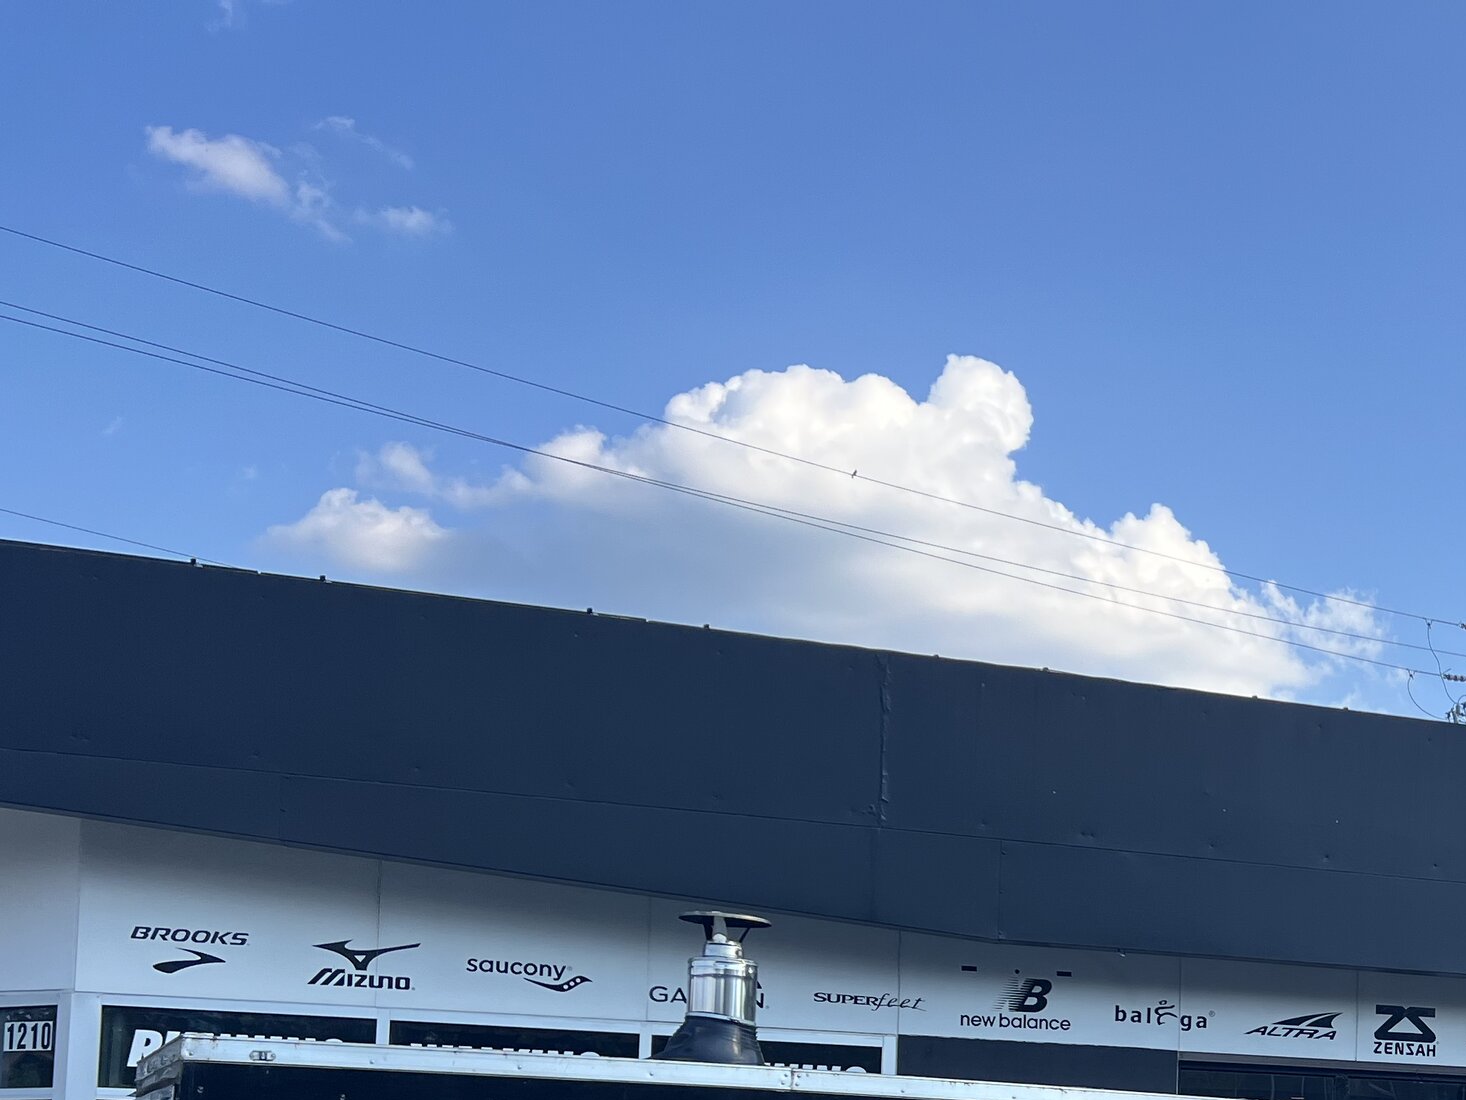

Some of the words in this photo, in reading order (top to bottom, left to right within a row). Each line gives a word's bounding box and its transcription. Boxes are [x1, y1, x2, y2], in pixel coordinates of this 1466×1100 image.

[130, 926, 249, 947] BROOKS
[466, 957, 567, 981] saucony
[960, 1013, 995, 1028] new
[999, 1013, 1071, 1031] balance
[7, 1022, 51, 1050] 1210
[1245, 1024, 1337, 1041] ALTRA
[1373, 1041, 1437, 1057] ZENSAH
